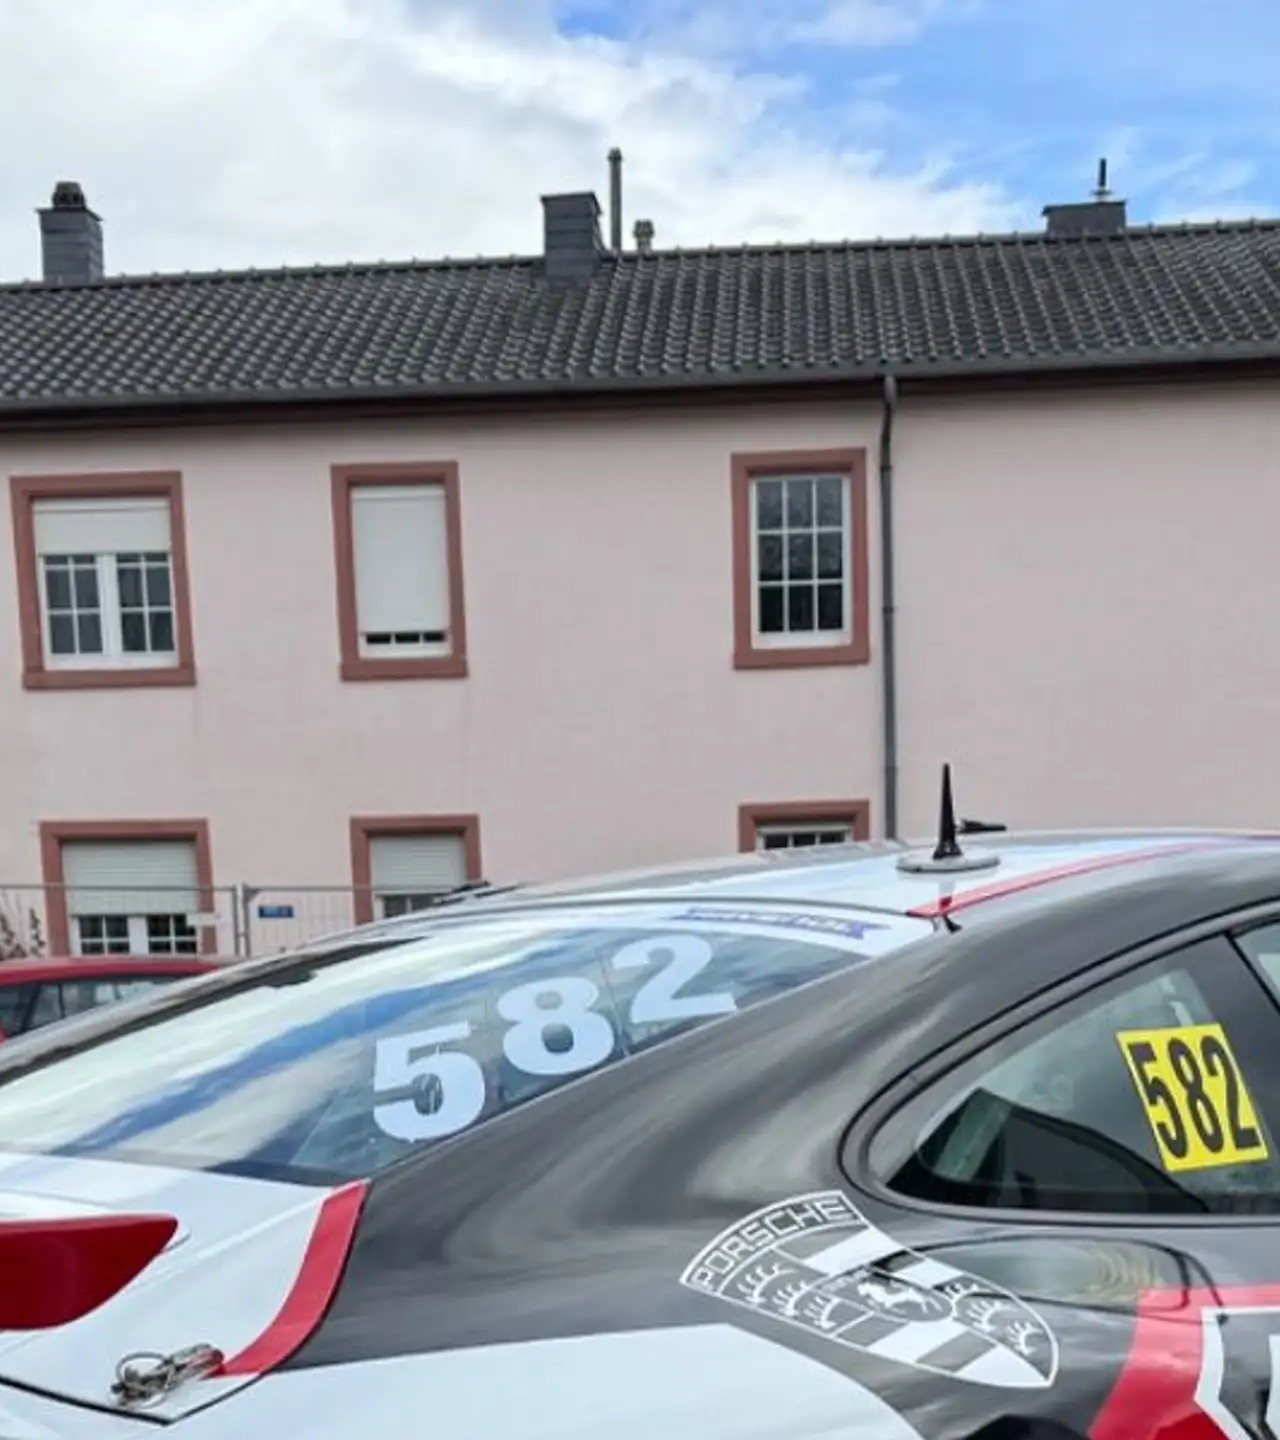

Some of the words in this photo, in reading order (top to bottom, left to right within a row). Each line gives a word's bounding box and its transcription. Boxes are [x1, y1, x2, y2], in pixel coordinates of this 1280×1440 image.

[373, 935, 738, 1143] 582
[1127, 1035, 1261, 1159] 582
[693, 1197, 858, 1292] PORSCHE
